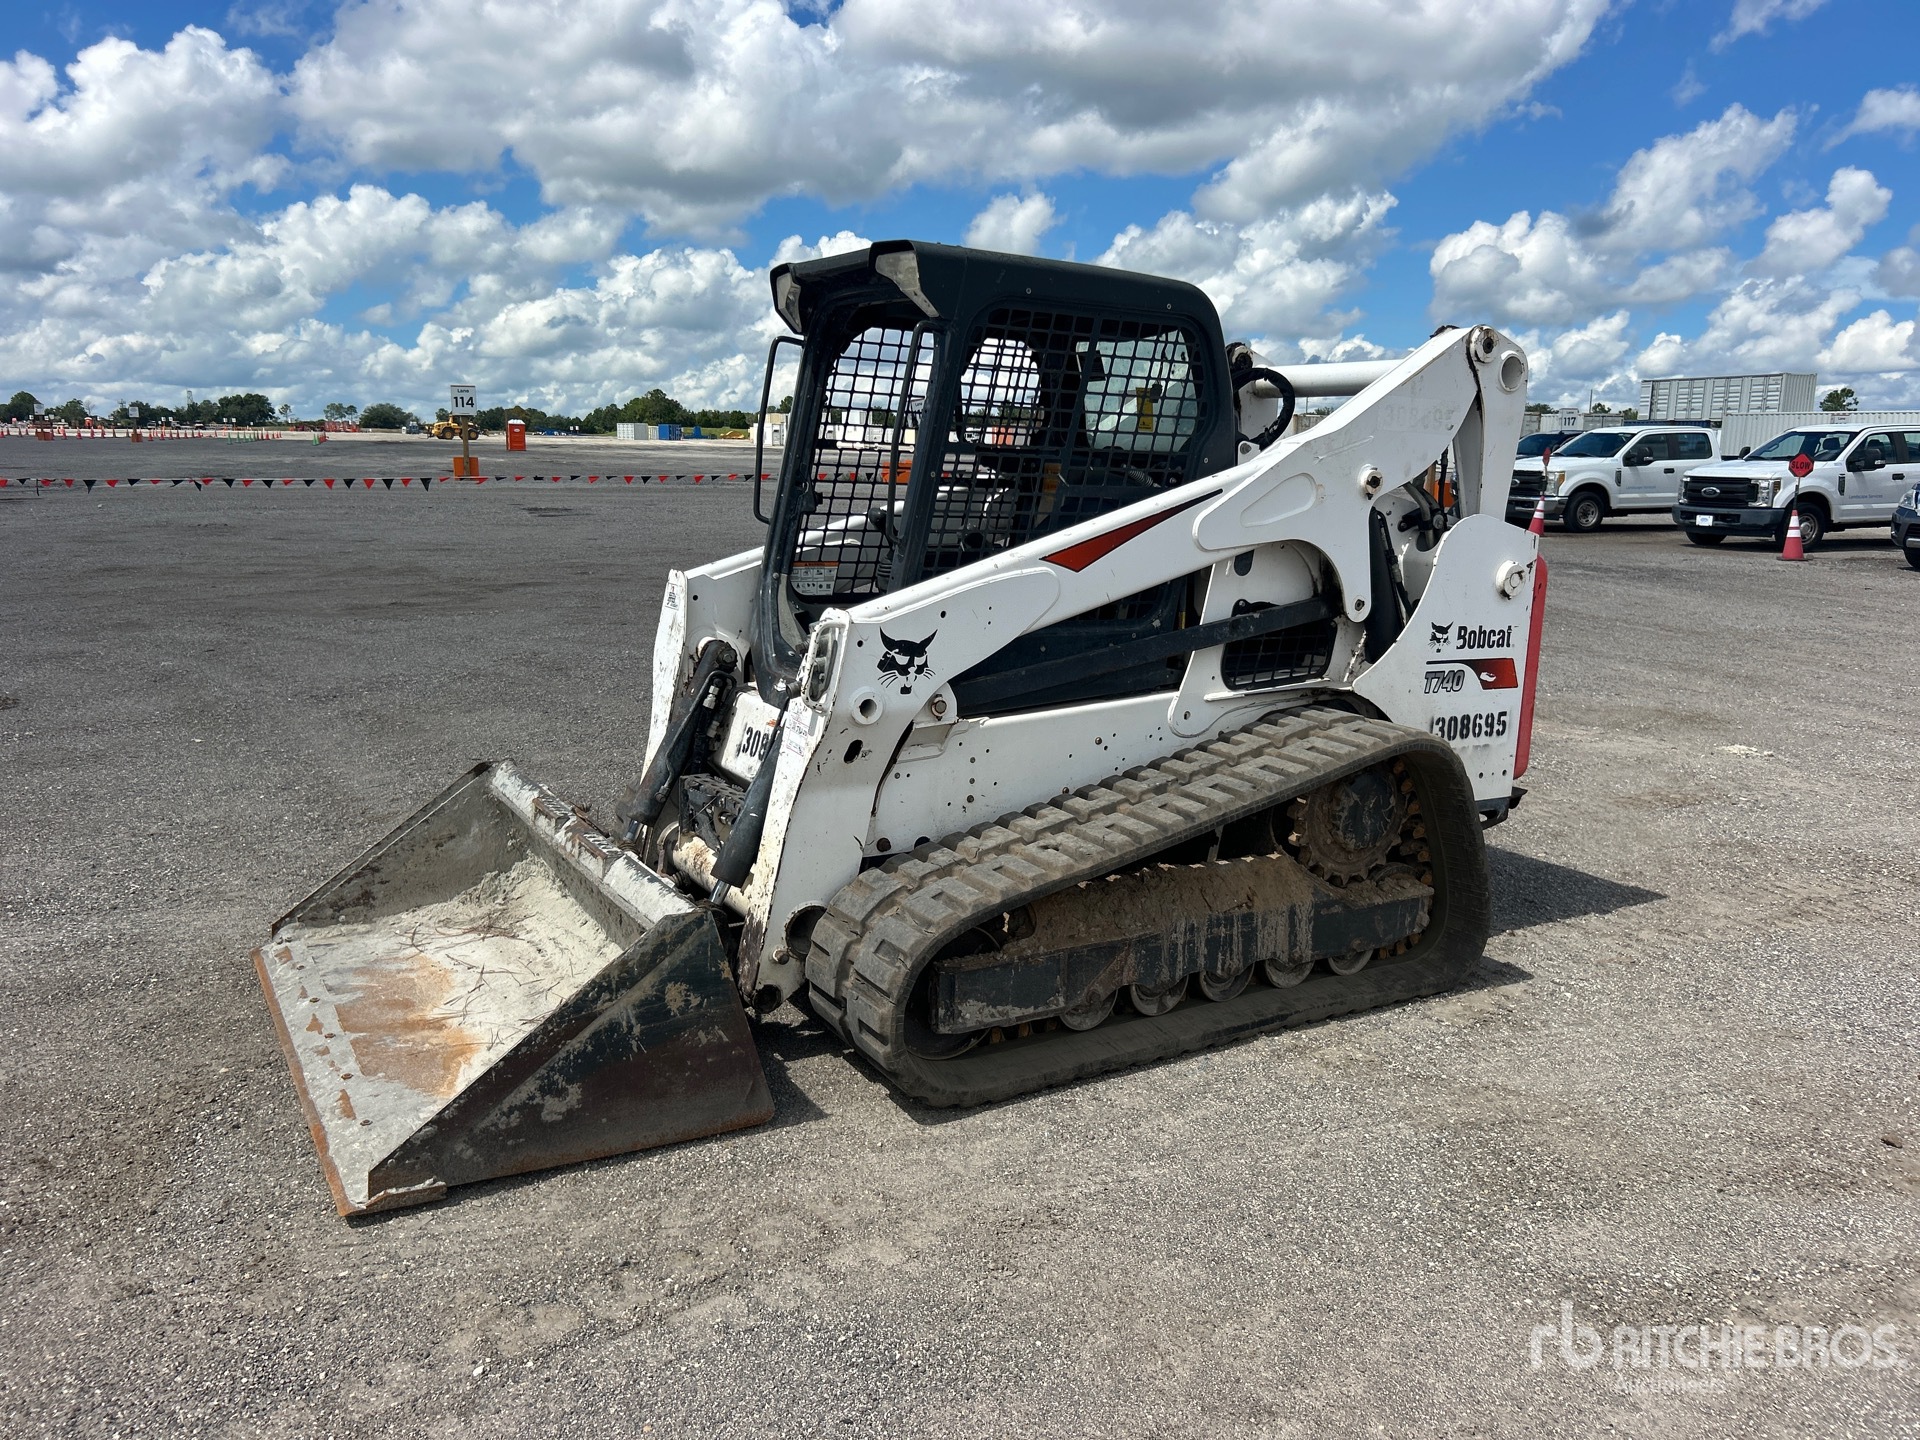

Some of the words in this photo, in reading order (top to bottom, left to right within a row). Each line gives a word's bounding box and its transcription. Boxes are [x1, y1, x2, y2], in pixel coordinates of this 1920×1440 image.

[453, 396, 475, 408] 114
[1563, 416, 1577, 426] 117
[1791, 461, 1811, 470] SLOW
[1456, 625, 1513, 650] Bobcat
[1424, 669, 1466, 694] T740
